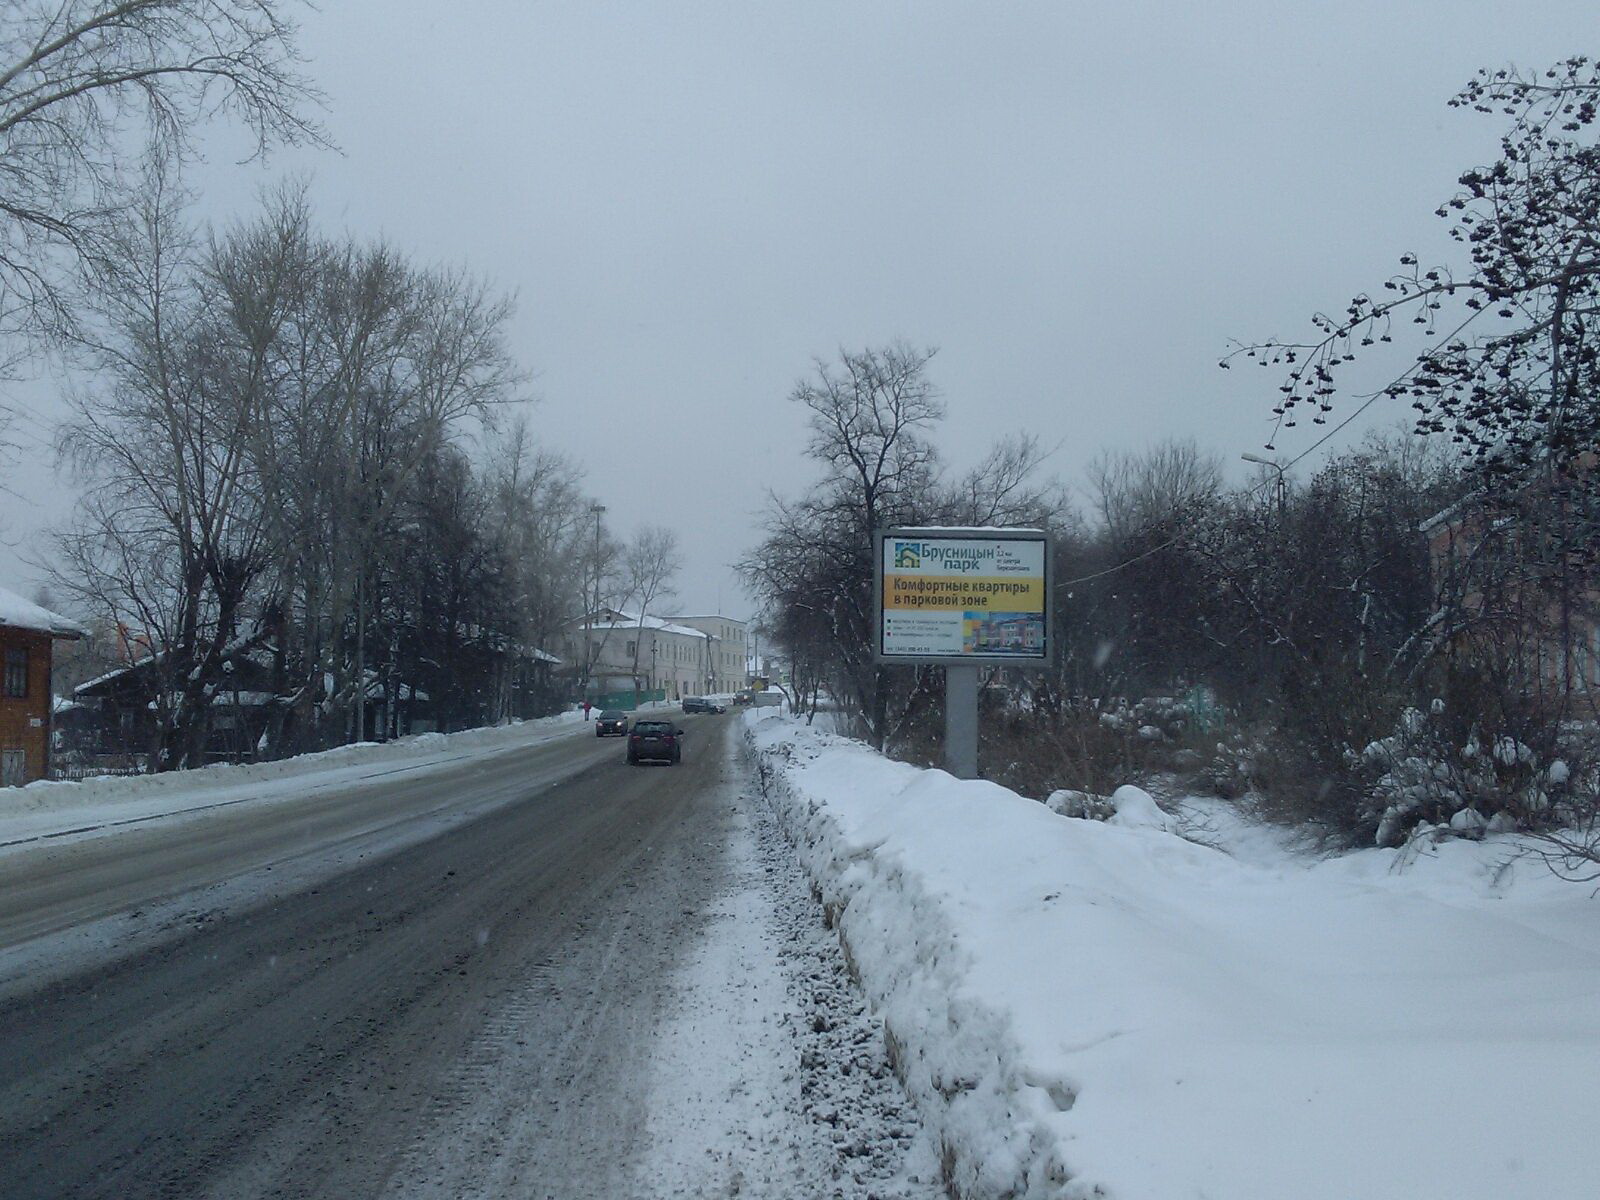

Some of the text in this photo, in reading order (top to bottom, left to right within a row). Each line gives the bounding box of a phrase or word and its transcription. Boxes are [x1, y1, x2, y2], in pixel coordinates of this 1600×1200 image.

[922, 543, 994, 561] Брусницын
[944, 559, 980, 572] парк
[894, 578, 1030, 597] Комфортные квартиры
[894, 593, 988, 609] в парковой зоне
